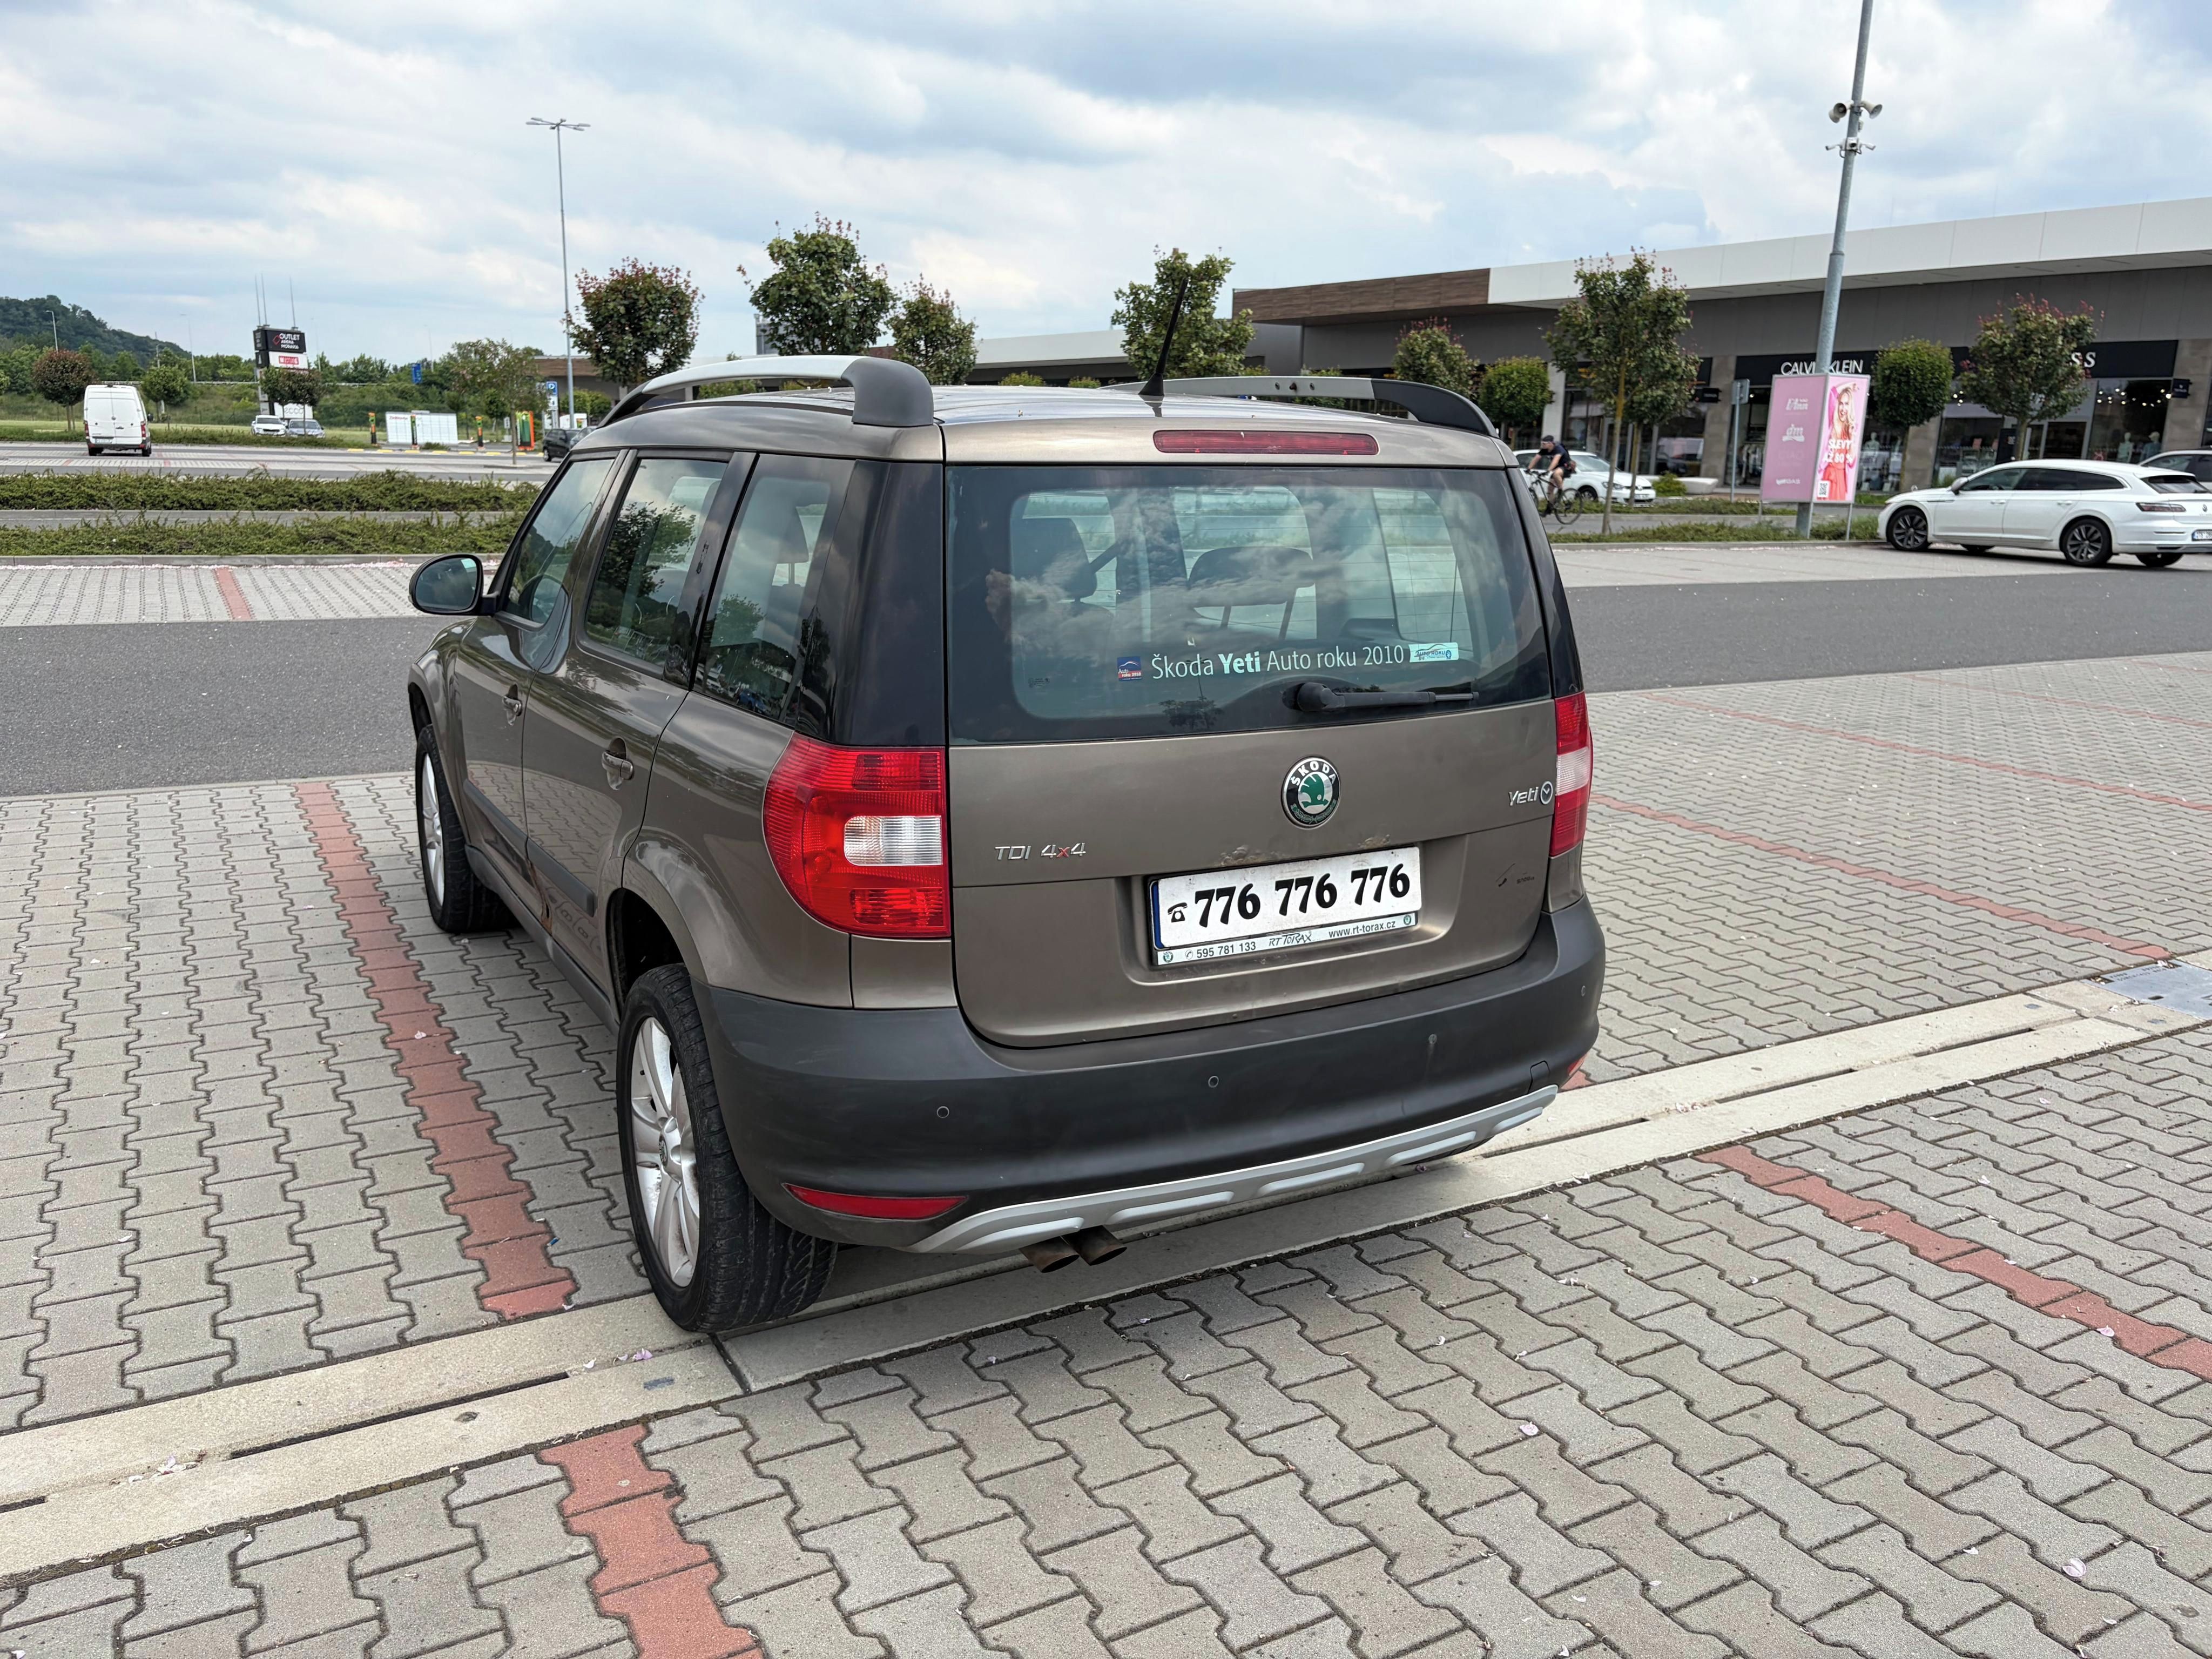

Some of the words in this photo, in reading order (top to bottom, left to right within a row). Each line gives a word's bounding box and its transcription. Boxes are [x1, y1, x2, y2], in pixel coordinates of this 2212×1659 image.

[279, 333, 300, 341] OUTLET
[1781, 361, 1816, 376] CALVI
[1151, 653, 1214, 679] Škoda
[1218, 651, 1260, 675] Yeti
[1267, 651, 1311, 671] Auto
[1317, 647, 1357, 669] roku
[1364, 645, 1404, 666] 2010
[1290, 761, 1337, 786] ŠKODA
[1508, 786, 1539, 806] Yeti
[995, 845, 1031, 860] TDI
[1041, 842, 1087, 859] 4x4
[1195, 882, 1261, 928] 776
[1274, 873, 1338, 917] 776
[1350, 863, 1411, 906] 776
[1197, 947, 1214, 959] 595
[1218, 944, 1235, 955] 781
[1239, 941, 1256, 952] 133
[1269, 938, 1282, 947] RT
[1328, 920, 1396, 938] www.rt-torax.cz
